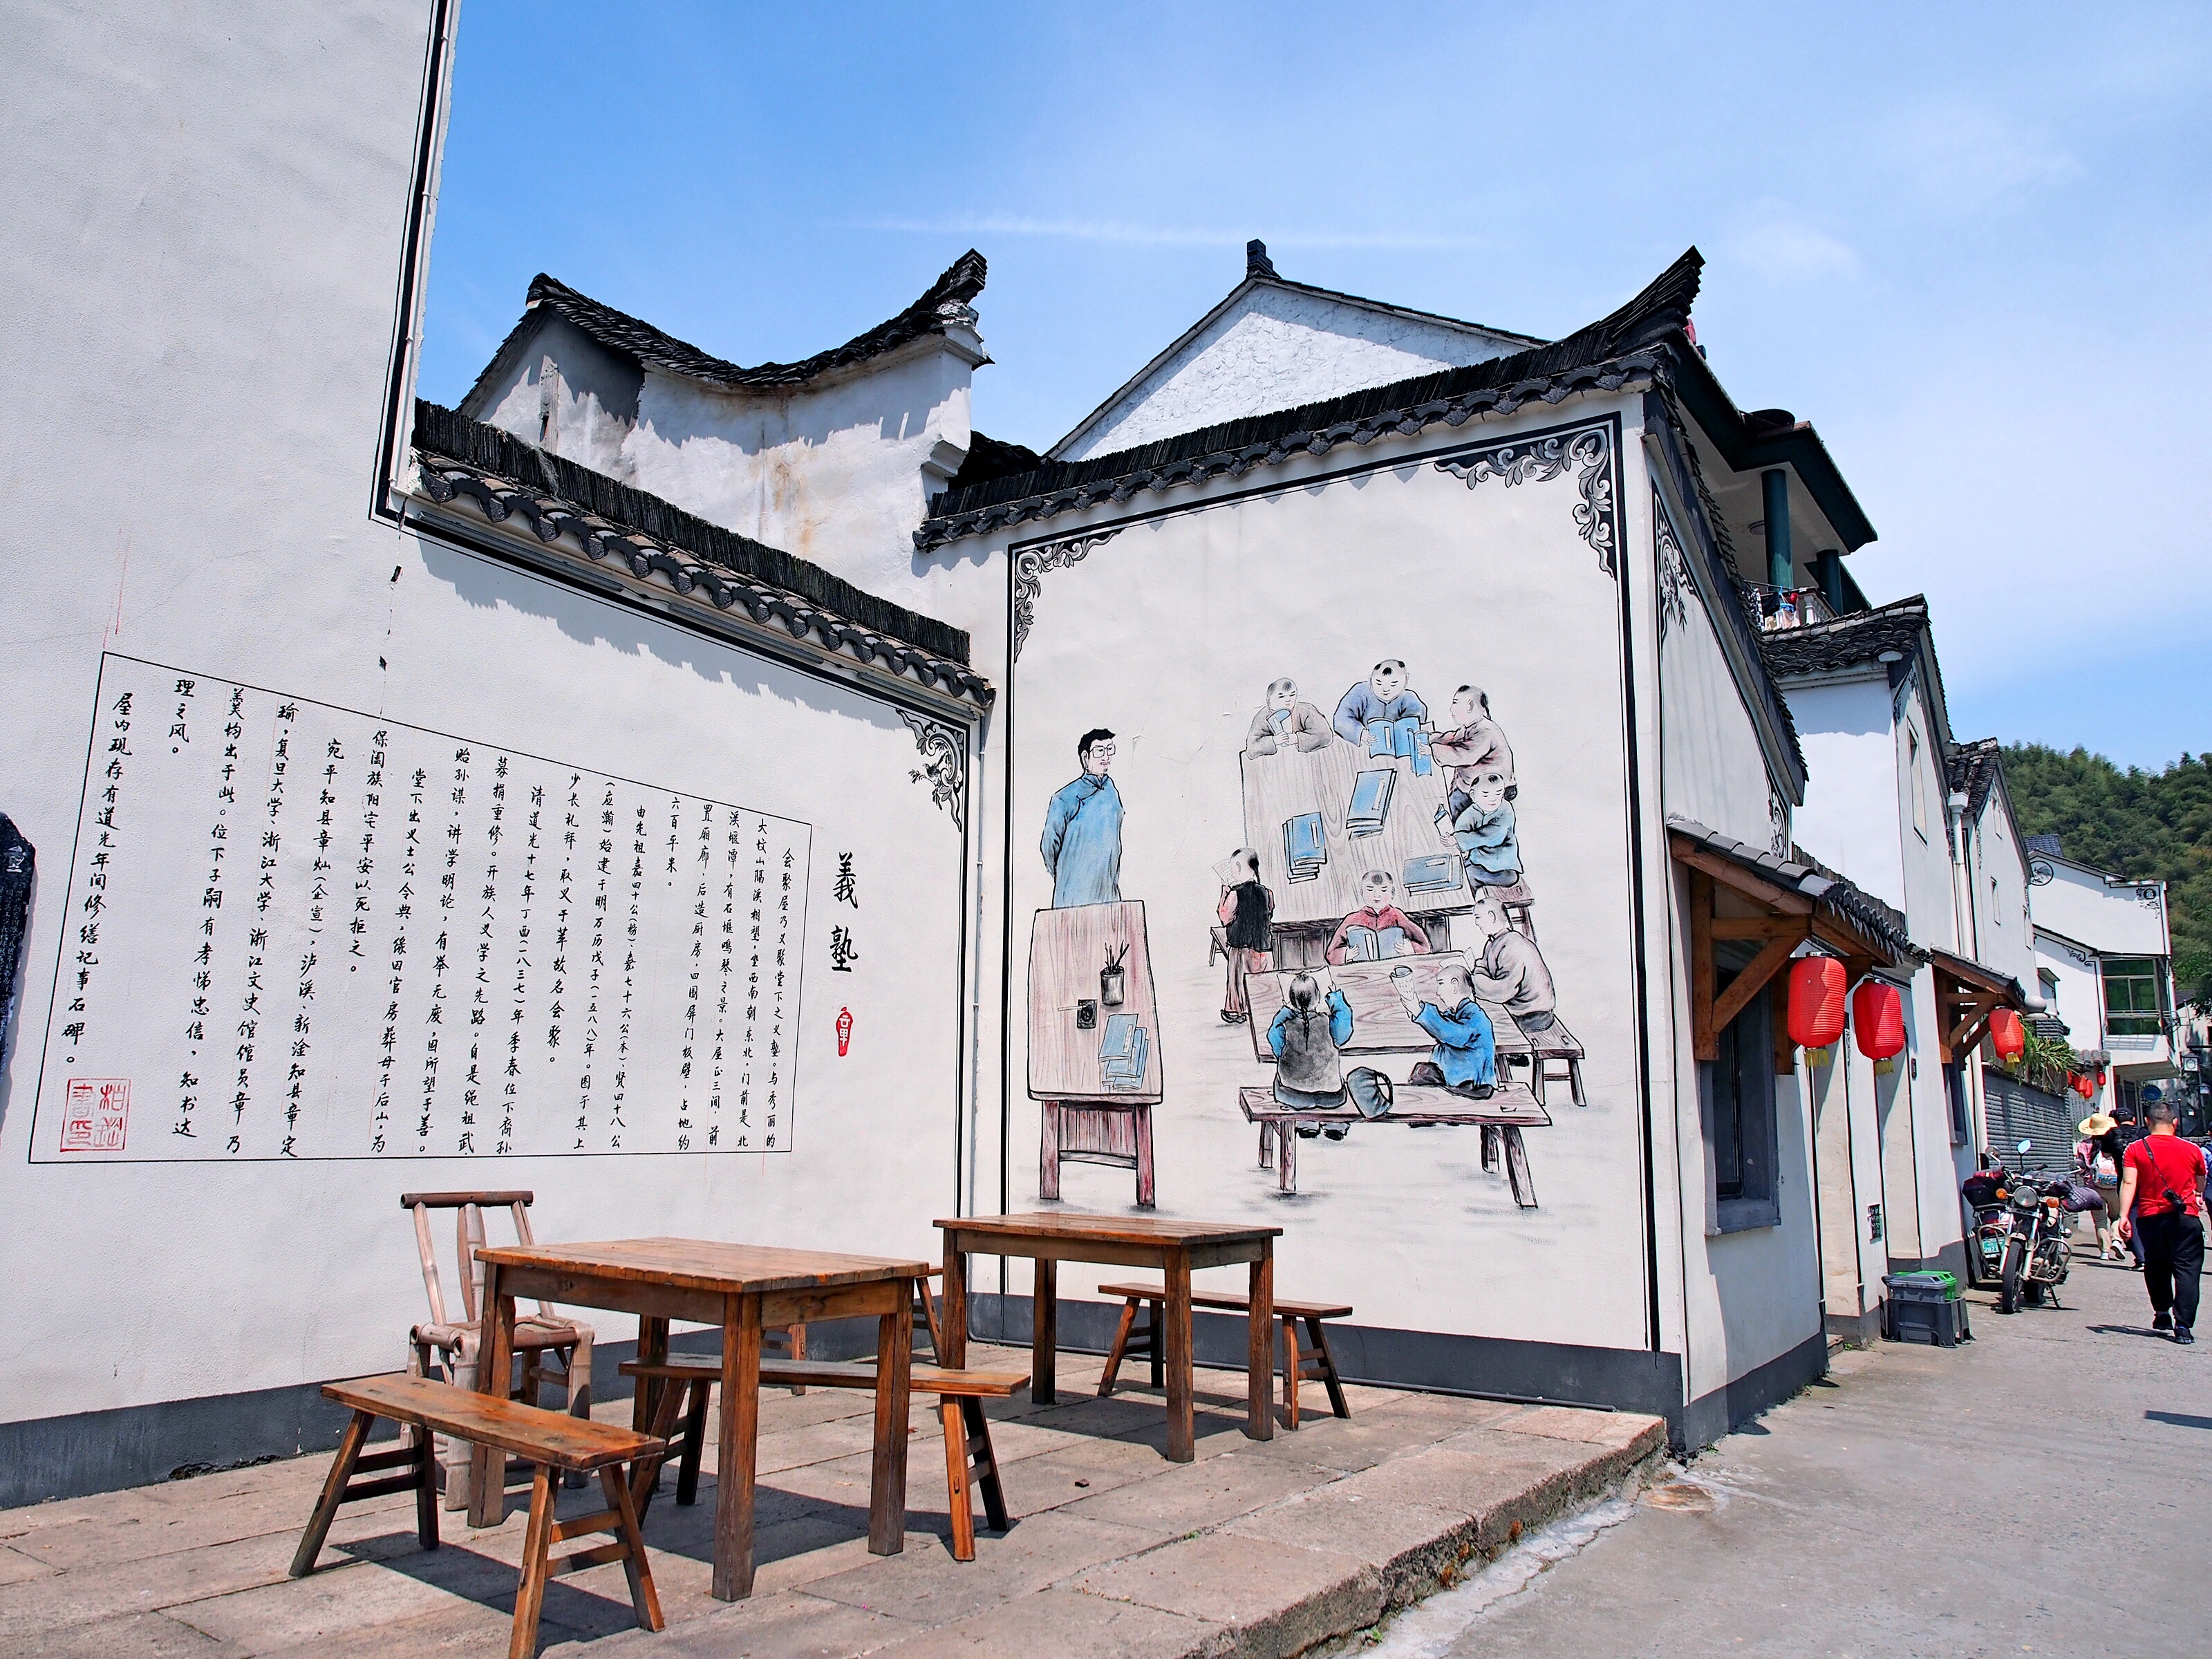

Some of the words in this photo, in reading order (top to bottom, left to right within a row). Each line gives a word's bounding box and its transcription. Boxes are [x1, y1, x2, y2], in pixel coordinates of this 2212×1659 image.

[167, 679, 195, 753] 理之风。
[666, 797, 679, 885] 六百平米。
